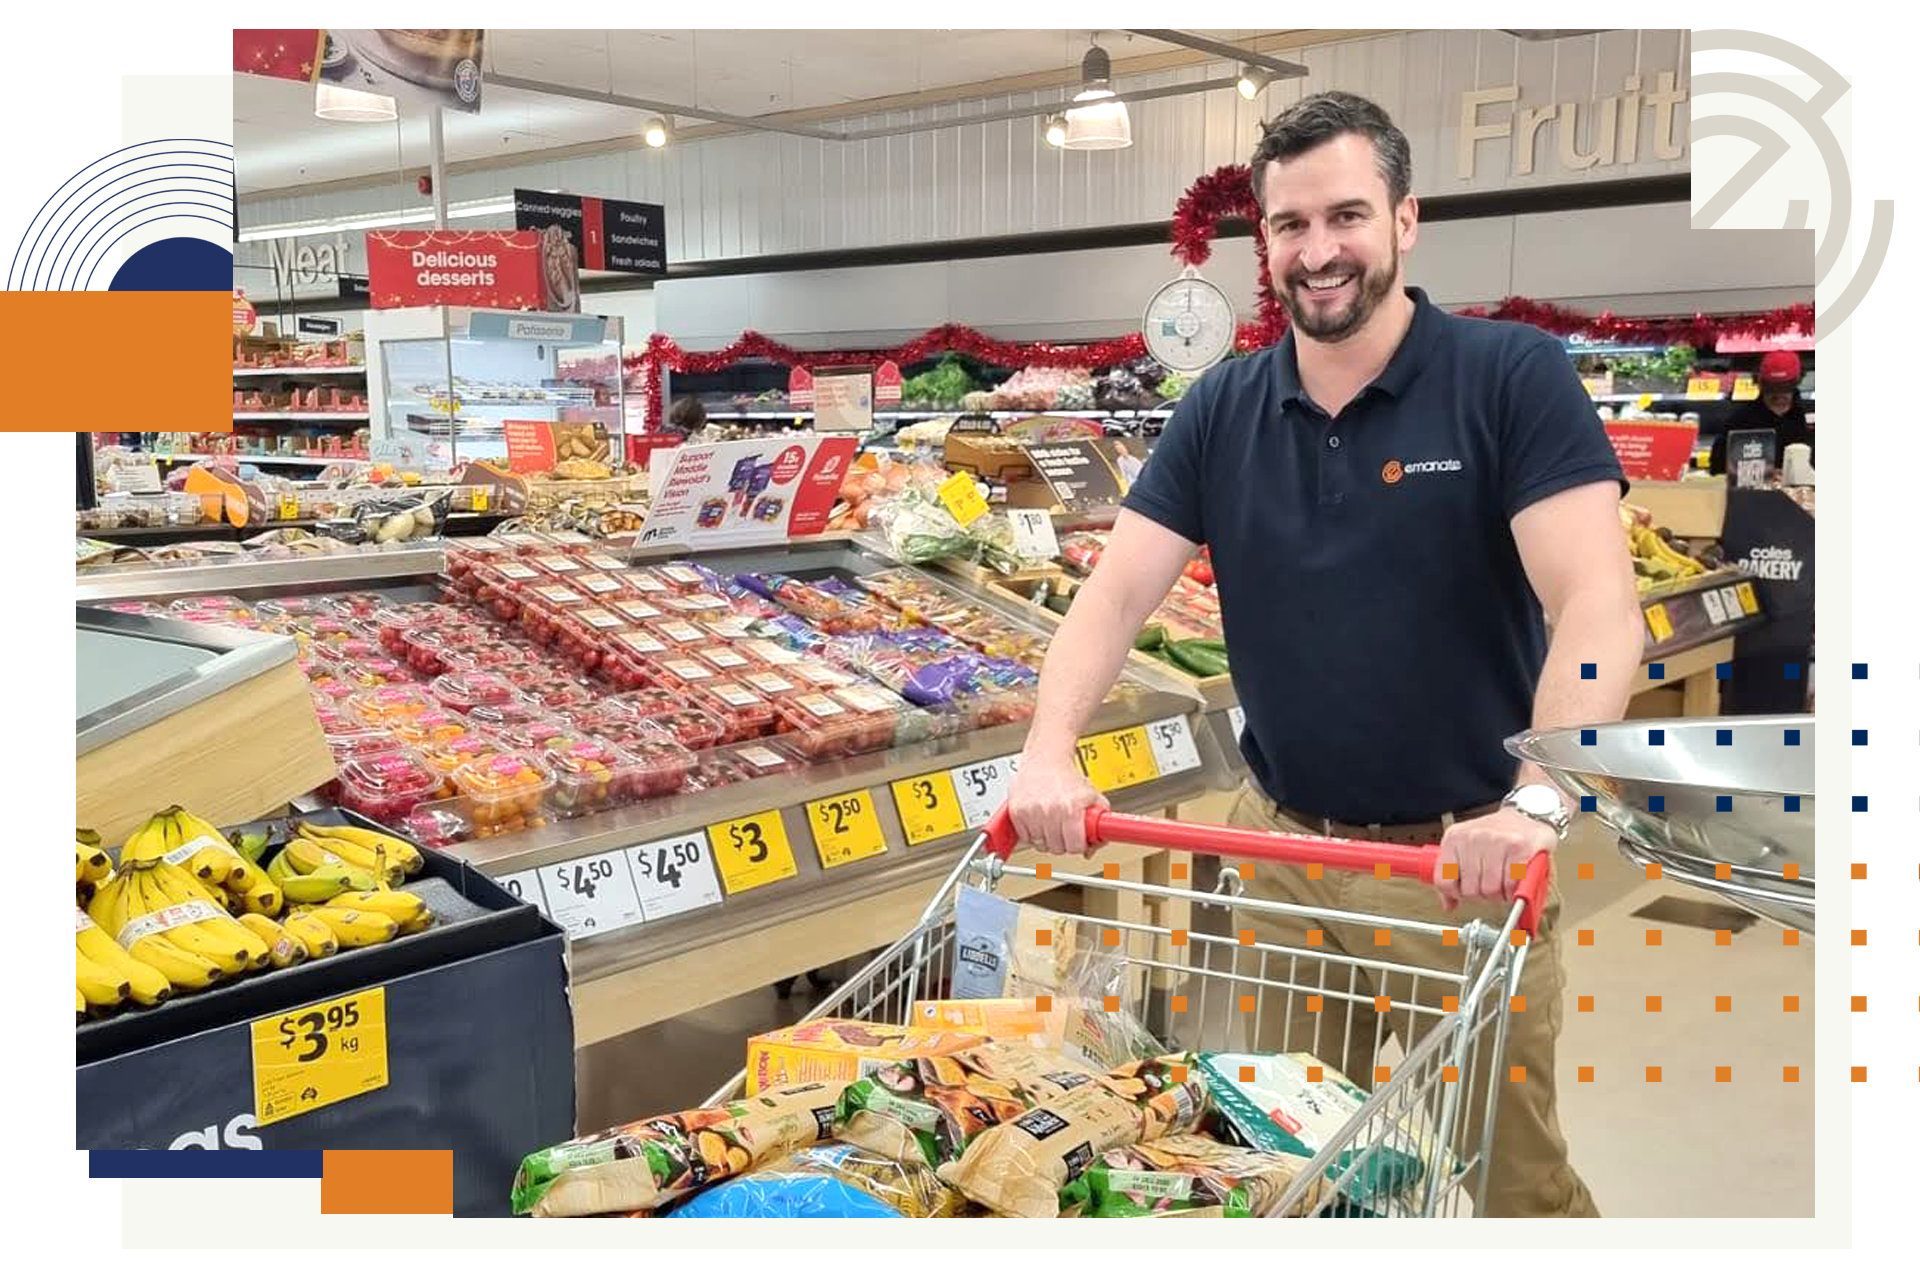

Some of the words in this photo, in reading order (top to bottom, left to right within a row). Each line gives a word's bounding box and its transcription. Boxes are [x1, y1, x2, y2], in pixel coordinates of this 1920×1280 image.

[1458, 71, 1688, 179] Fruit
[620, 212, 647, 226] Poultry
[590, 230, 597, 244] 1
[611, 234, 658, 246] Sandwiches
[267, 233, 348, 286] Meat
[412, 251, 497, 267] Delicious
[611, 255, 632, 266] Fresh
[417, 270, 495, 285] desserts
[1404, 459, 1462, 473] emanate
[1750, 546, 1792, 560] coles
[1738, 558, 1803, 581] BAKERY
[1112, 732, 1138, 759] $175
[962, 764, 998, 797] $550
[912, 780, 938, 810] $3
[819, 797, 861, 834] $250
[729, 821, 769, 863] $3
[638, 841, 701, 889] $450
[557, 859, 613, 899] $450
[279, 1000, 360, 1063] $395
[340, 1036, 359, 1053] kg
